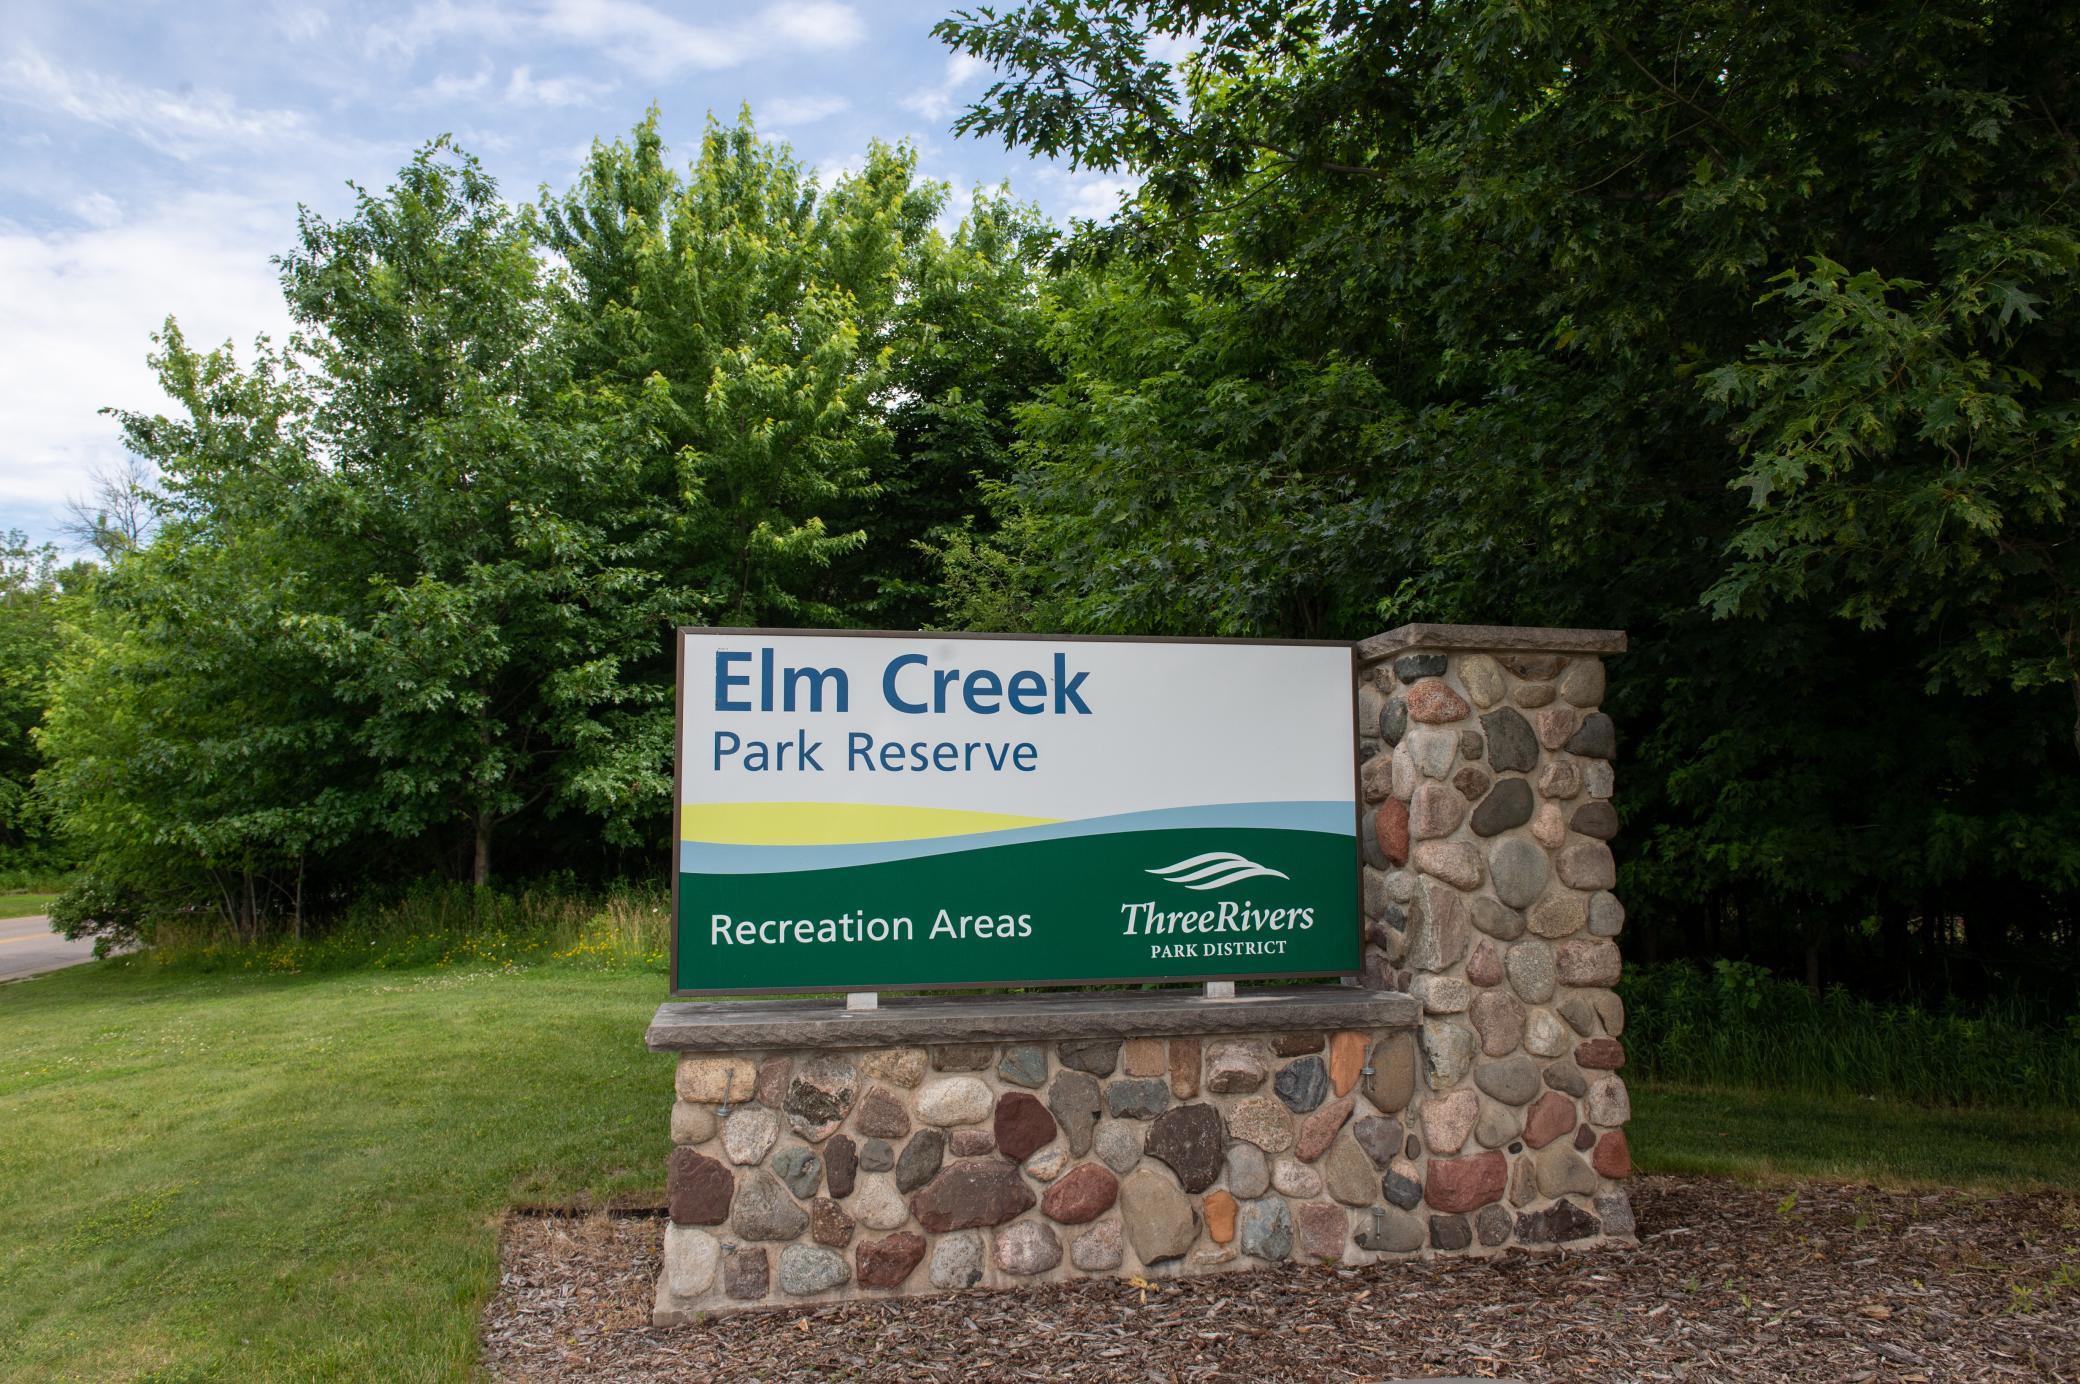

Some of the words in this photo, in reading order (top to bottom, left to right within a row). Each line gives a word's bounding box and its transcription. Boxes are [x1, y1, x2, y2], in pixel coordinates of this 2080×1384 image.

[715, 648, 849, 713] Elm
[882, 652, 1093, 716] Creek
[713, 729, 825, 773] Park
[848, 731, 1039, 773] Reserve
[711, 910, 913, 945] Recreation
[929, 909, 1033, 940] Areas
[1150, 944, 1198, 959] PARK
[1203, 940, 1287, 957] DISTRICT
